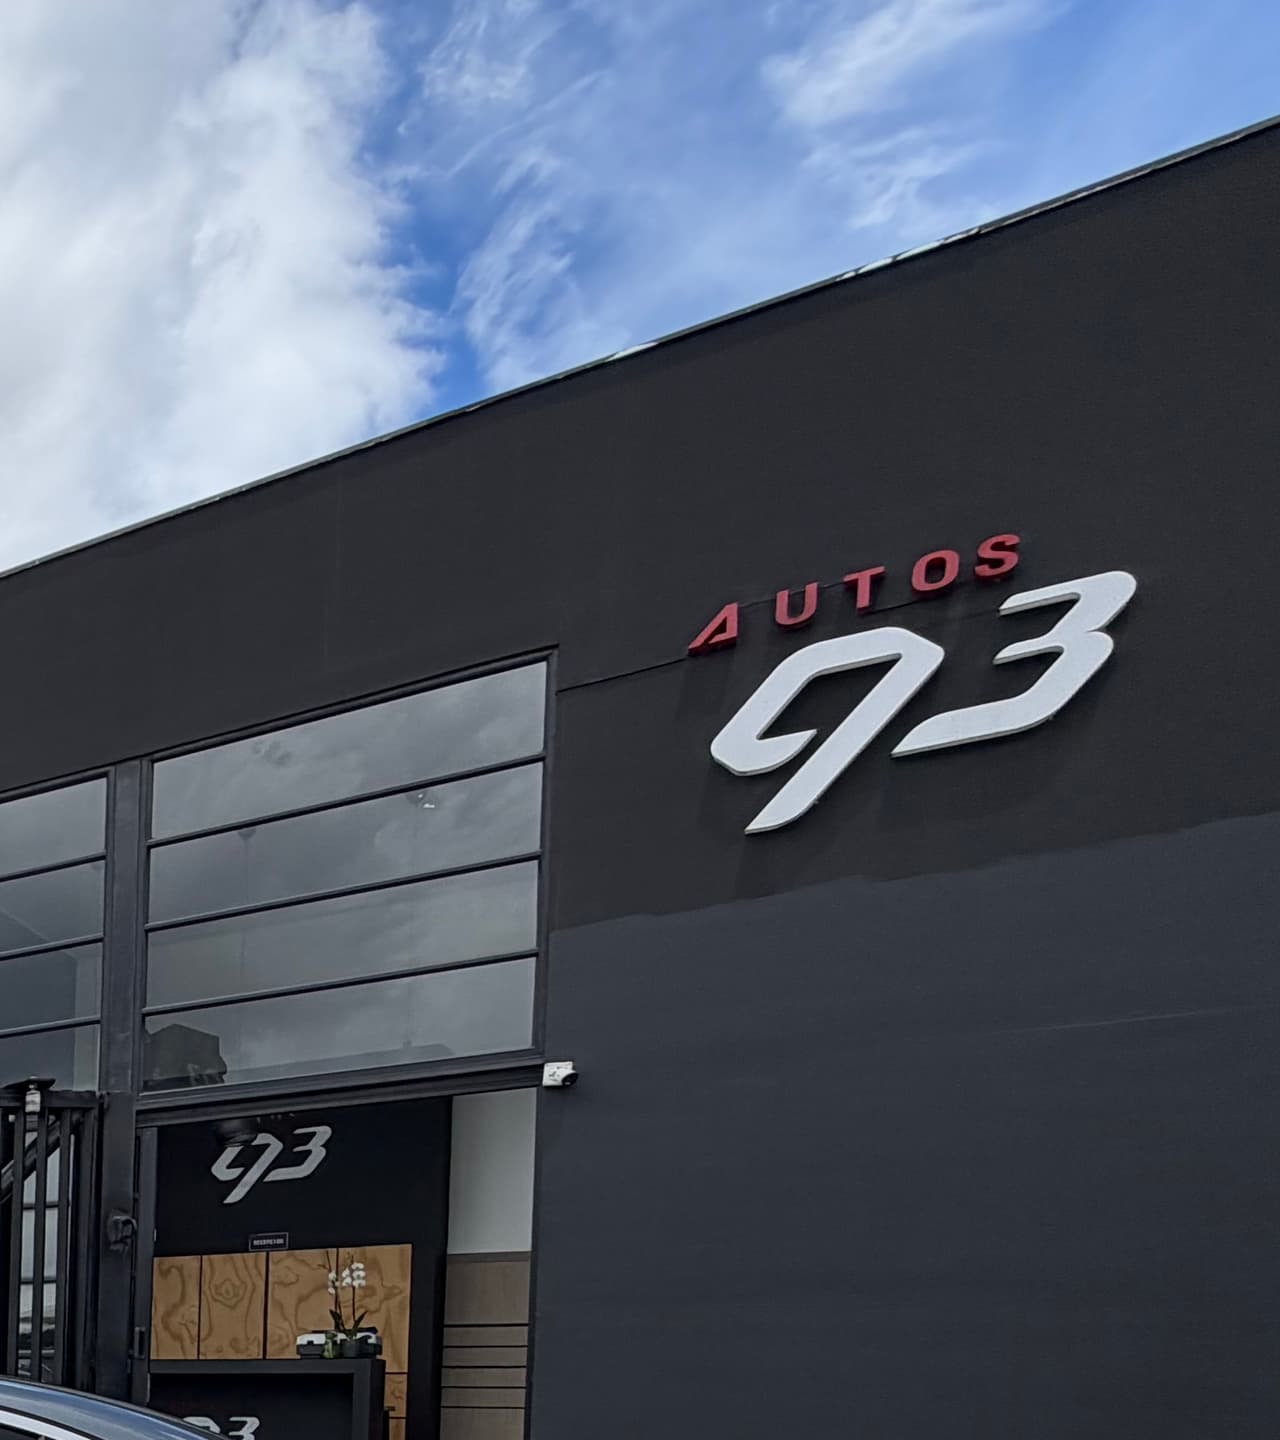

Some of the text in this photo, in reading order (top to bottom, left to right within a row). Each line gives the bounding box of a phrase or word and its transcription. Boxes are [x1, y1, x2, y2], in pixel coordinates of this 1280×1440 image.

[687, 532, 1022, 657] AUTOS
[710, 569, 1138, 836] 93
[210, 1125, 332, 1204] 93
